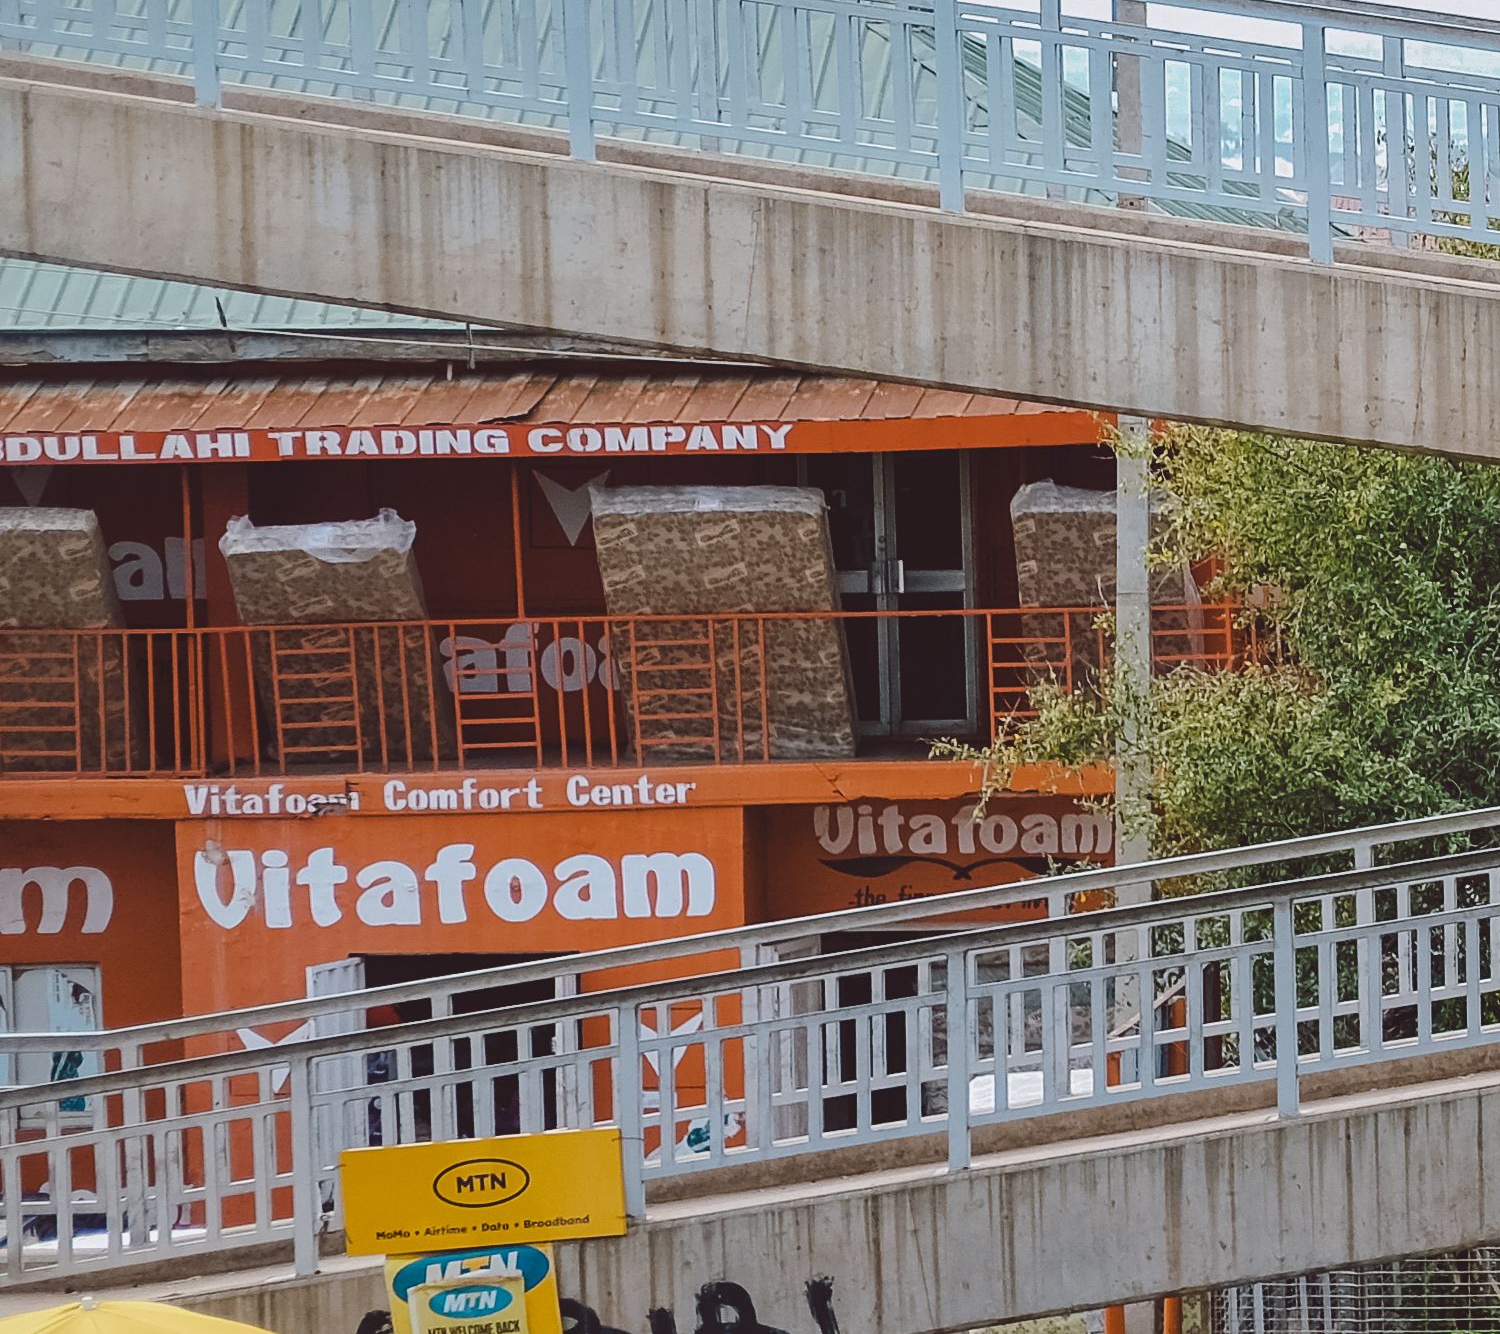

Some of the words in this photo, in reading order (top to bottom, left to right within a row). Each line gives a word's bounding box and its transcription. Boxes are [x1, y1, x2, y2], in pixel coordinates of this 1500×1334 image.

[0, 435, 250, 463] DULLAHI
[268, 428, 510, 456] TRADING
[527, 424, 793, 452] COMPANY
[383, 778, 543, 811] Comfort
[566, 774, 697, 807] Center
[813, 804, 1113, 855] Vitafoam
[194, 843, 716, 930] Vitafoam
[457, 1172, 507, 1194] MTN
[376, 1230, 411, 1241] MoMo
[423, 1224, 468, 1237] Airtime
[481, 1221, 510, 1232] Data
[523, 1214, 591, 1229] Broadband
[443, 1289, 497, 1314] MTN
[496, 1320, 520, 1334] BACK
